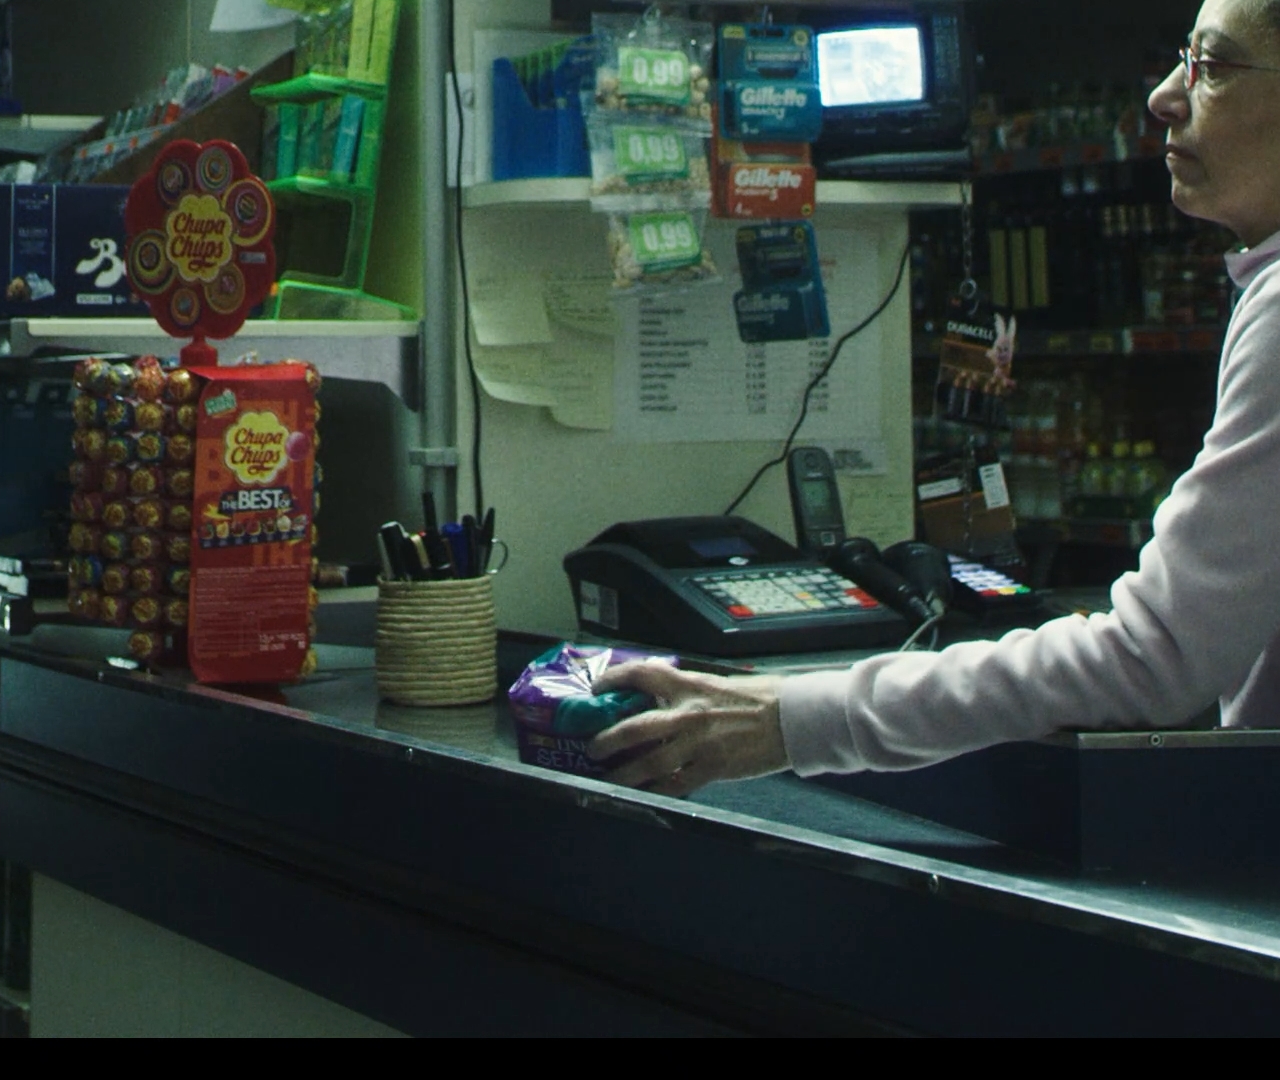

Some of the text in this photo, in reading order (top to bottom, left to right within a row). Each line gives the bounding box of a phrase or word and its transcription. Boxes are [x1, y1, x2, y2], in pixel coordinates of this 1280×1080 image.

[740, 86, 807, 108] Gillette
[734, 166, 803, 188] Gillette
[174, 212, 225, 239] Chupa
[170, 235, 224, 269] Chups
[234, 427, 283, 449] Chupa
[230, 446, 281, 475] Chups
[238, 489, 282, 510] BEST
[536, 748, 590, 769] SETA
